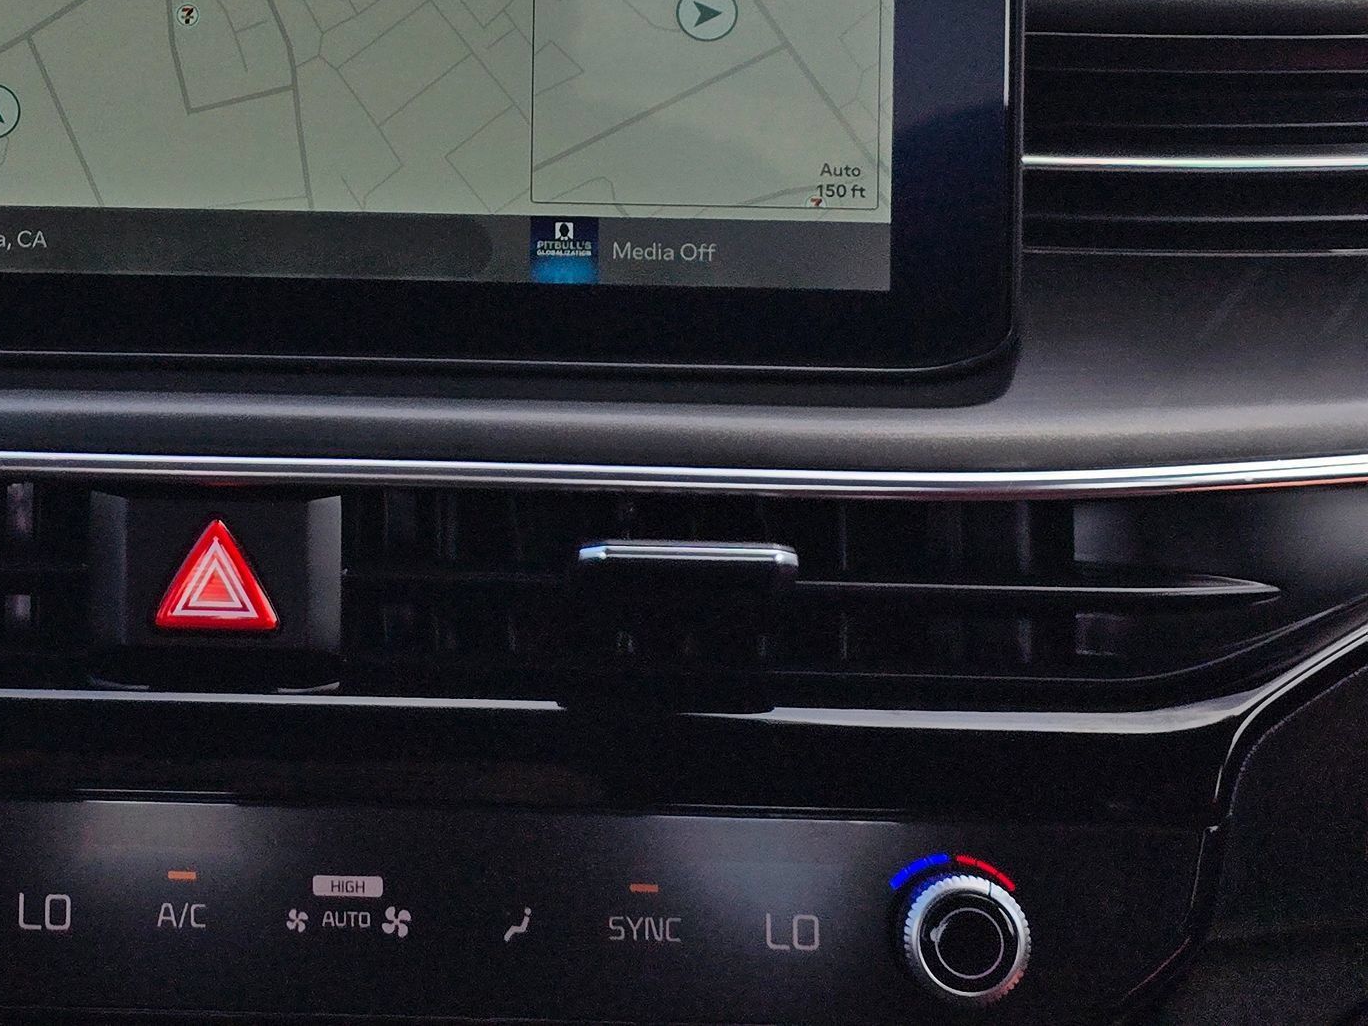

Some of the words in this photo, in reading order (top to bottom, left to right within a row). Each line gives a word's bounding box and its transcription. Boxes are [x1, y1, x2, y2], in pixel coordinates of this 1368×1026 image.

[819, 162, 862, 178] Auto
[815, 183, 848, 199] 150
[850, 184, 867, 199] ft
[16, 229, 48, 249] CA
[536, 239, 593, 250] PITBULL'S
[611, 241, 675, 262] Media
[680, 242, 717, 262] Off
[330, 879, 366, 894] HIGH
[18, 891, 72, 931] LO
[156, 901, 207, 929] A/C
[321, 910, 371, 928] AUTO
[608, 915, 682, 943] SYNC
[765, 912, 820, 951] LO
